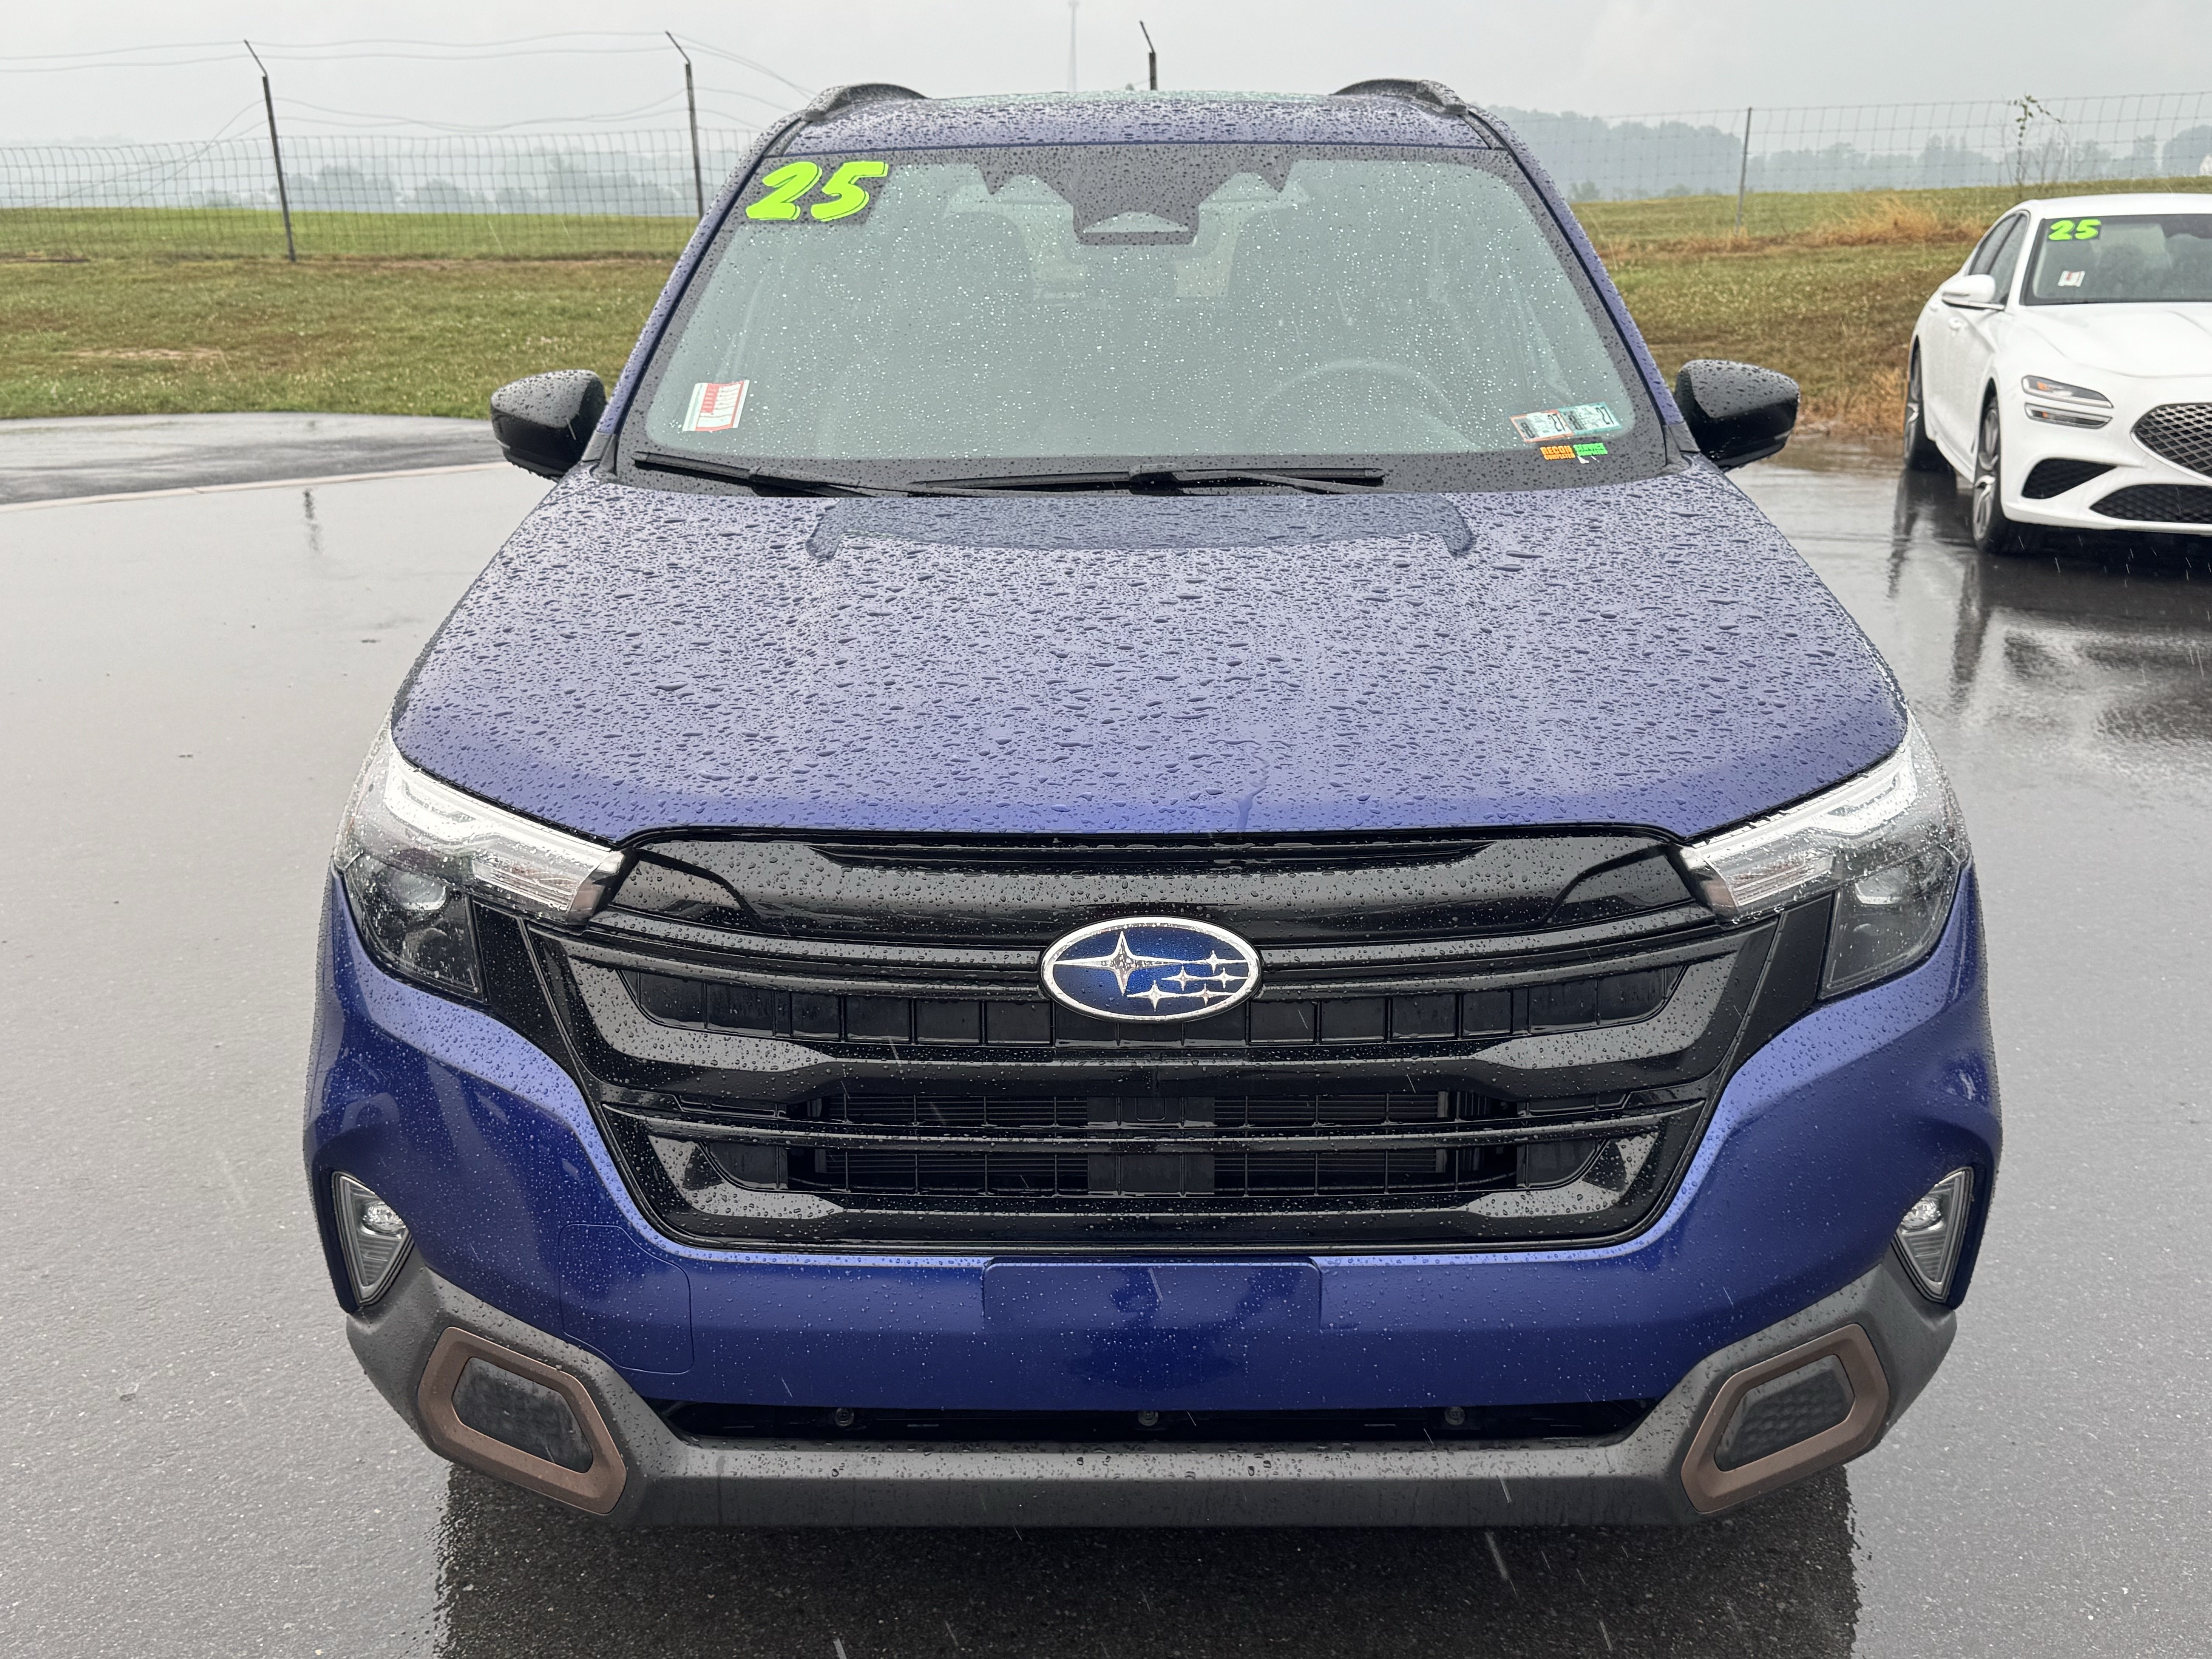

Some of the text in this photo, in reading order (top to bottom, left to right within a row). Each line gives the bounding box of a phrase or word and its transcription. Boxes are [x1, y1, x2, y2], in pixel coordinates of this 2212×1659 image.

[746, 161, 889, 222] 25
[2048, 219, 2102, 240] 25
[1539, 445, 1573, 455] RECON
